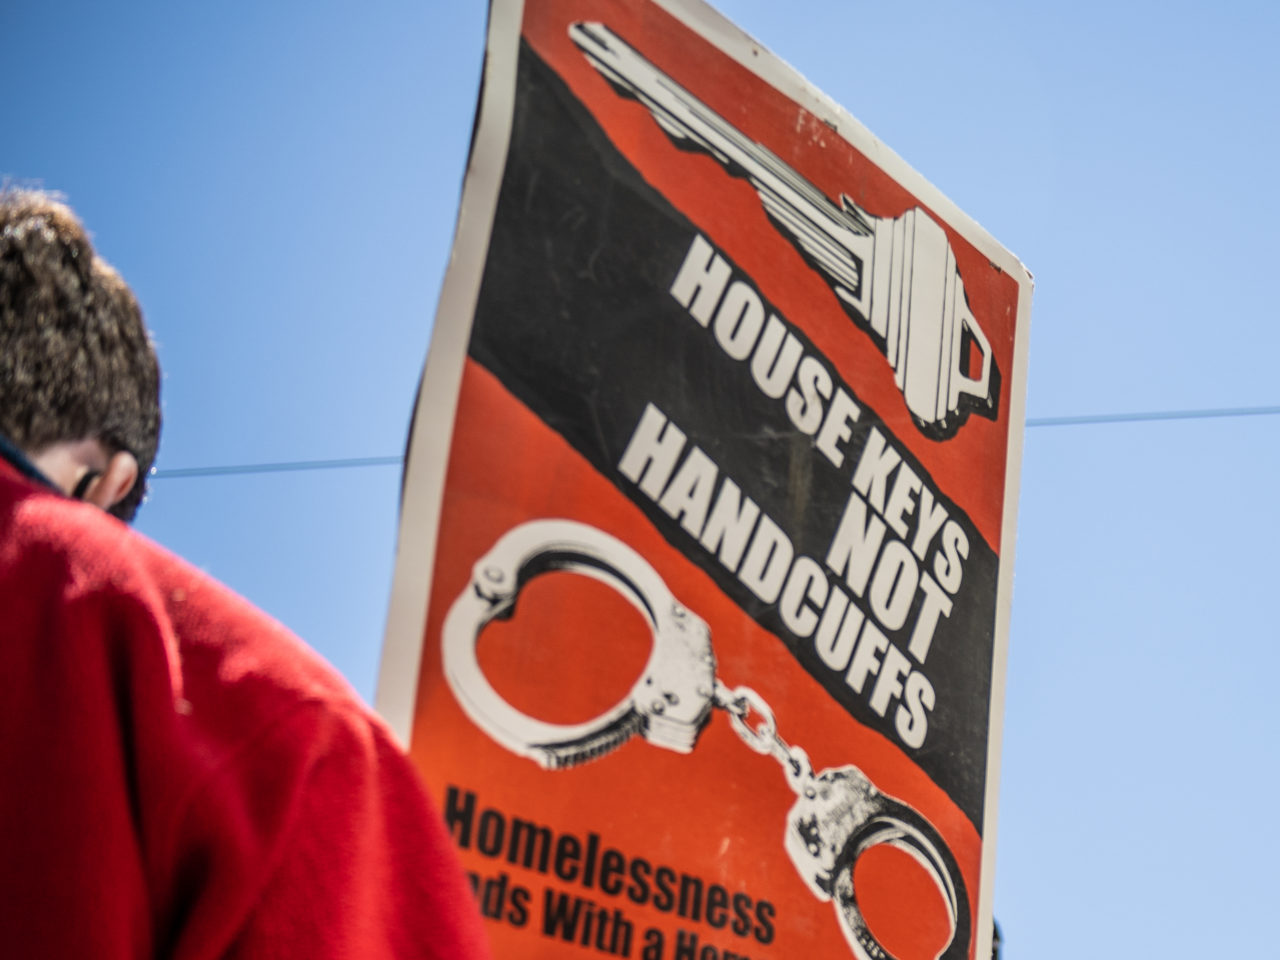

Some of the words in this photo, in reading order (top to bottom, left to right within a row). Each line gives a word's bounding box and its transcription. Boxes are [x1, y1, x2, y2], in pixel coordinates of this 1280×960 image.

[670, 233, 861, 469] HOUSE
[852, 426, 970, 594] KEYS
[617, 402, 936, 750] HANDCUFFS
[826, 491, 954, 665] NOT
[445, 784, 776, 945] Homelessness
[542, 887, 634, 960] With
